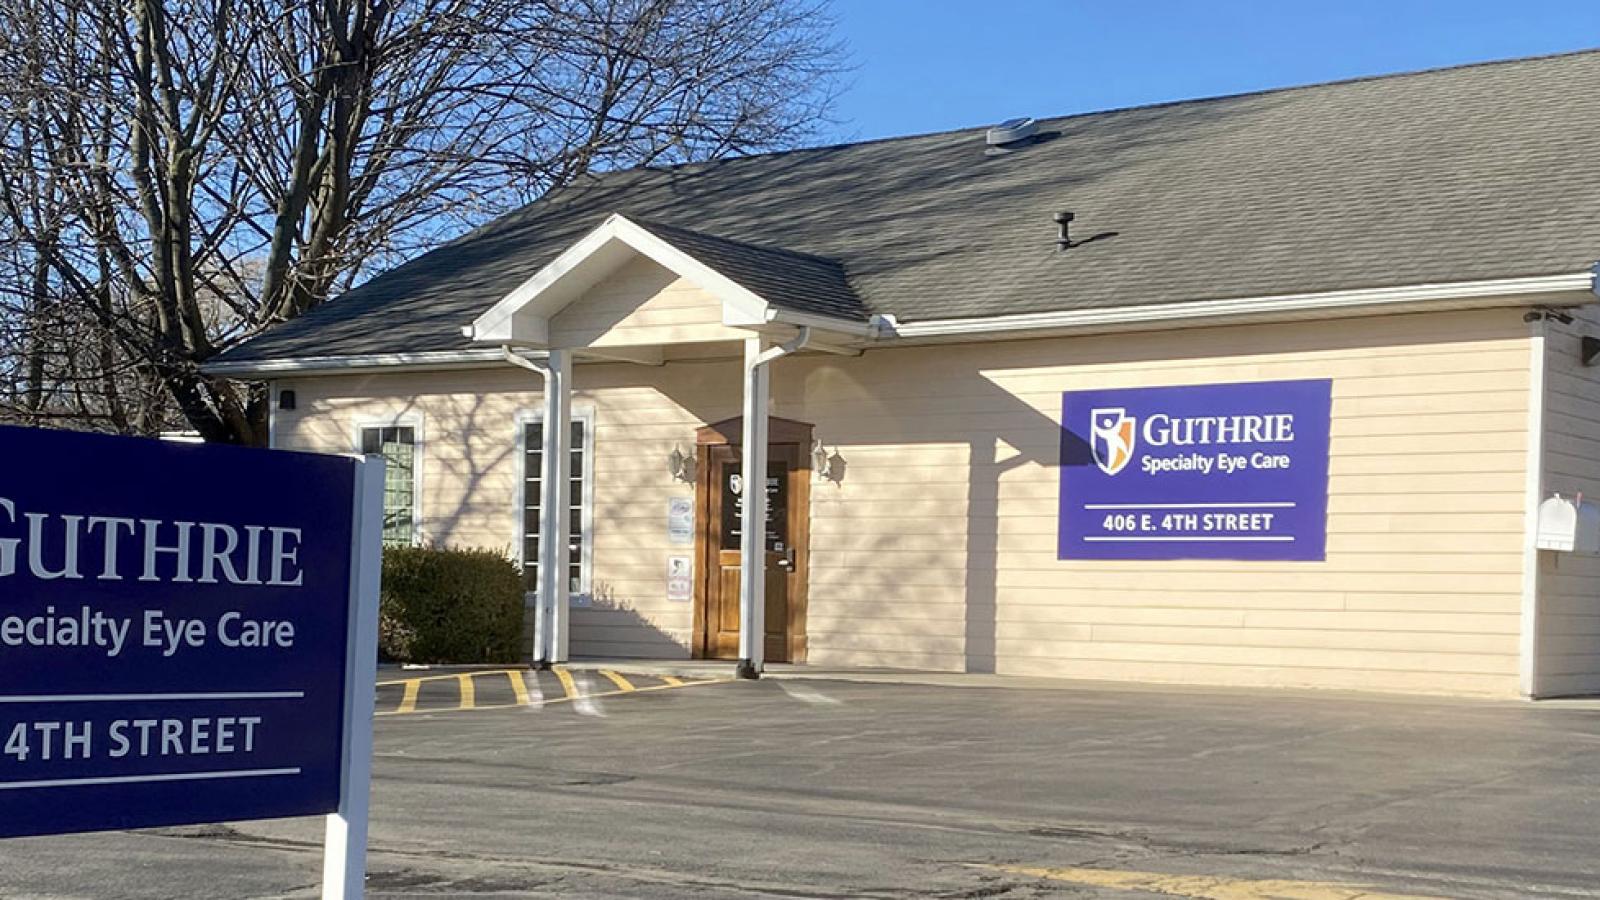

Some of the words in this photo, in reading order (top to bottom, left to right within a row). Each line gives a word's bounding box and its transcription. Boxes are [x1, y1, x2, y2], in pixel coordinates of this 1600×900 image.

[1142, 413, 1295, 446] GUTHRIE
[1141, 452, 1214, 476] Specialty
[1217, 453, 1248, 474] Eye
[1250, 452, 1291, 469] Care
[0, 496, 304, 586] UTHRIE
[1102, 514, 1137, 531] 406
[1141, 514, 1157, 531] E.
[1161, 513, 1198, 531] 4TH
[1203, 513, 1274, 531] STREET
[0, 606, 132, 657] ecialty
[143, 609, 207, 657] Eye
[217, 611, 295, 647] Care
[4, 720, 92, 761] 4TH
[109, 716, 261, 757] STREET
